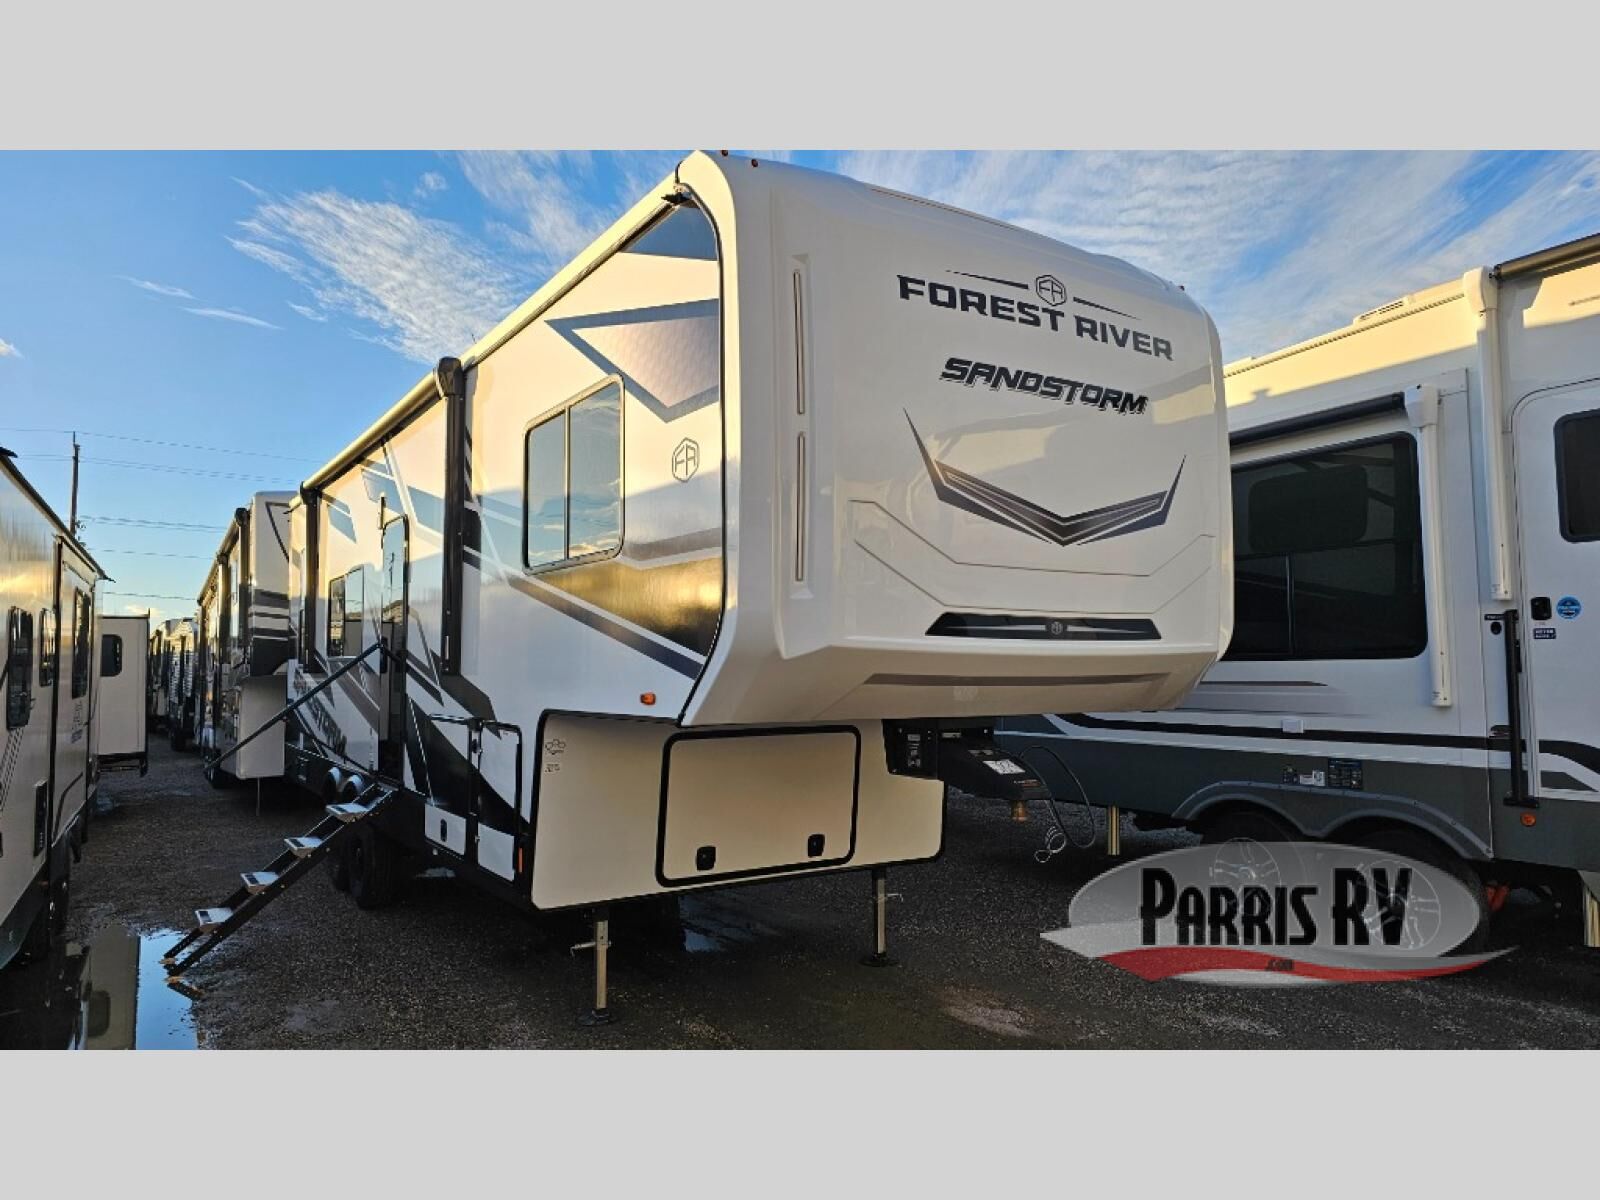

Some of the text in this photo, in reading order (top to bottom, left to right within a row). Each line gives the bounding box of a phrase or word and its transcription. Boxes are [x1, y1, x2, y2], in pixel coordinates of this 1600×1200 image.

[897, 275, 1173, 361] FOREST RIVER
[940, 357, 1148, 414] SANDSTORM
